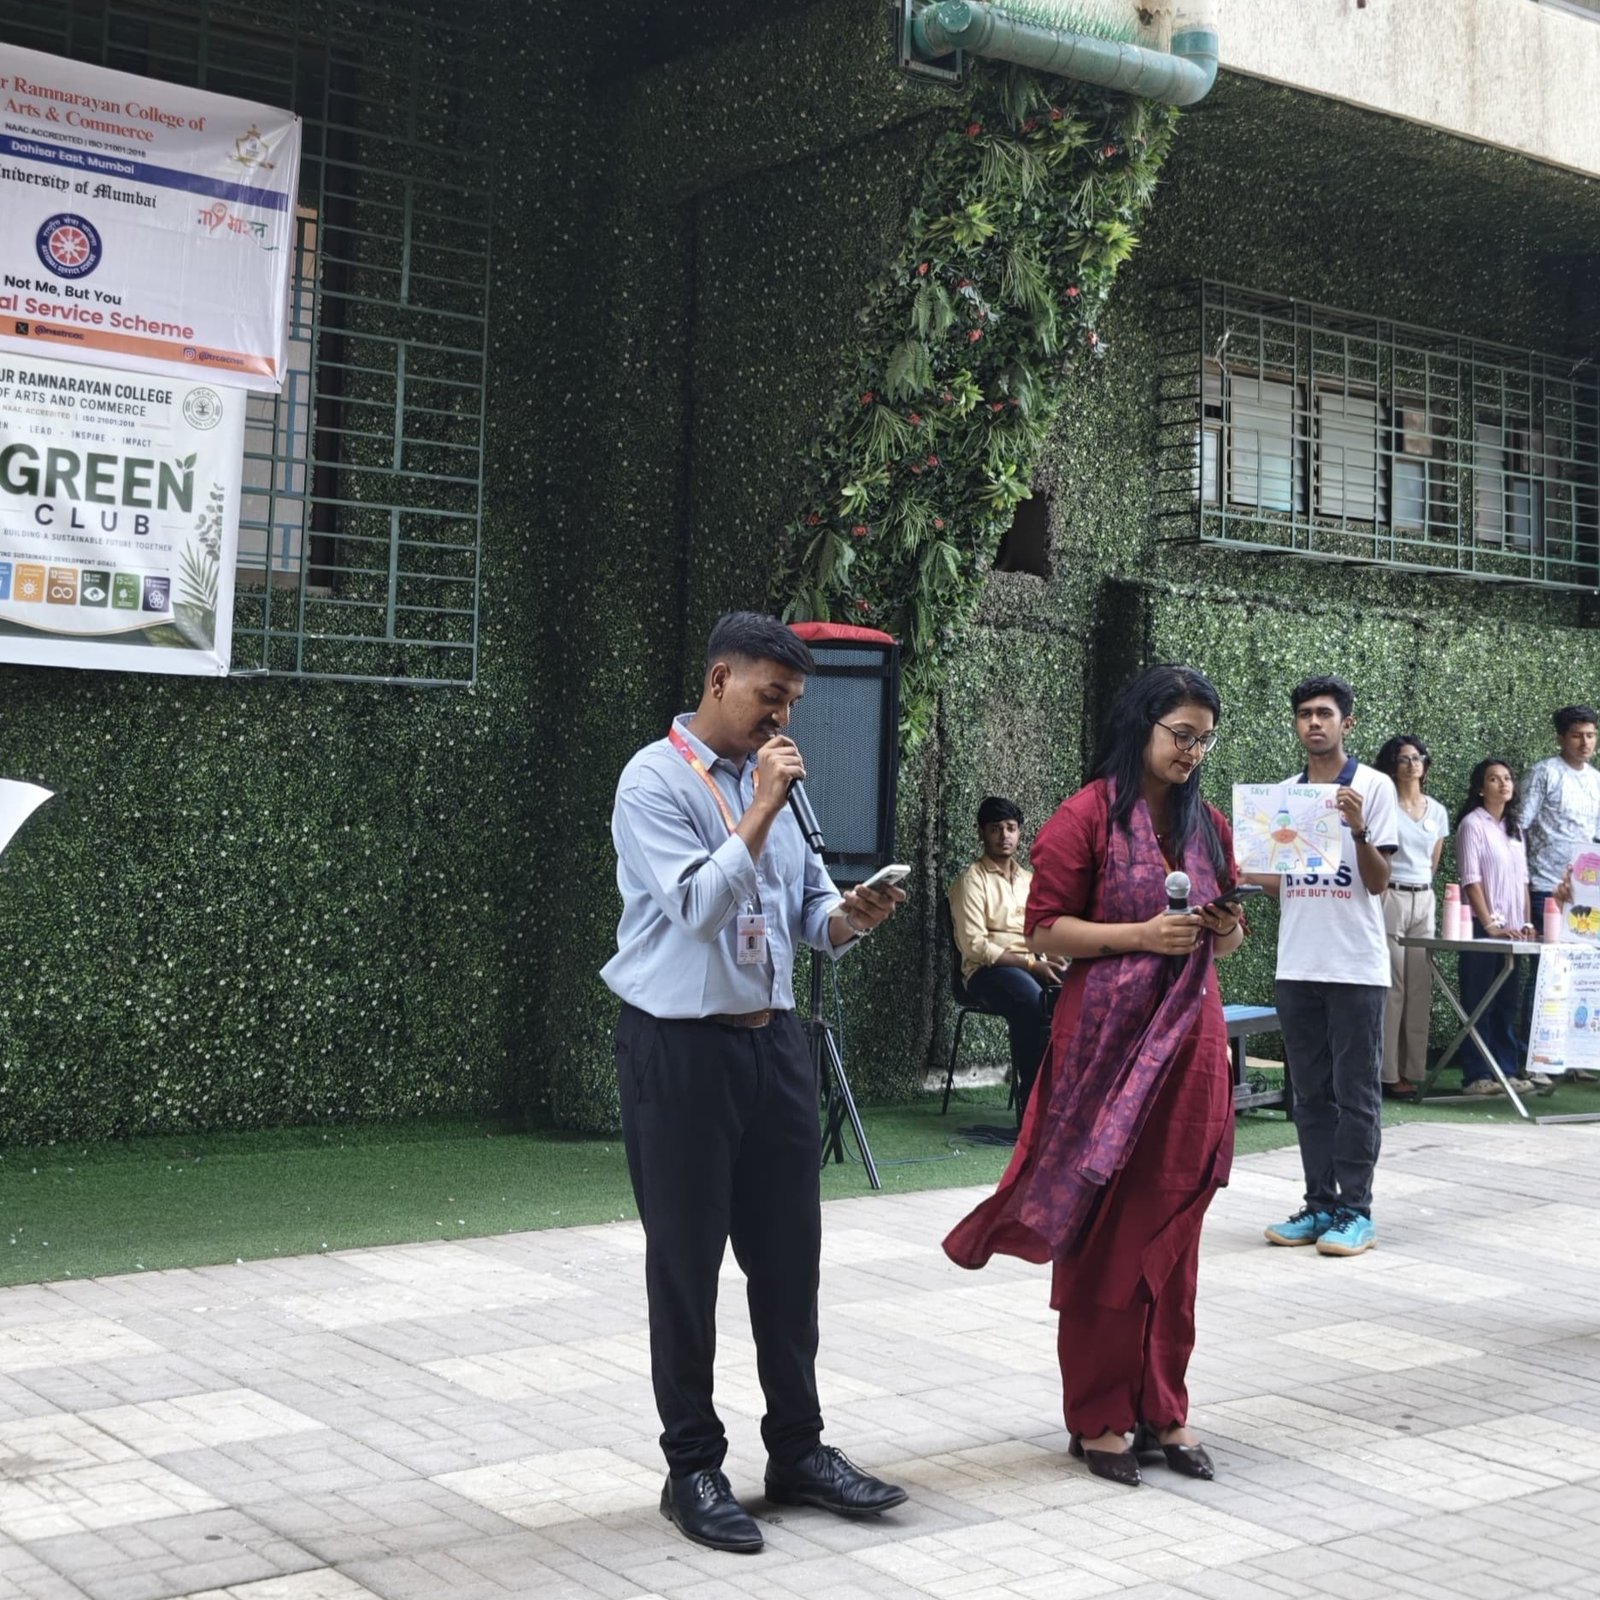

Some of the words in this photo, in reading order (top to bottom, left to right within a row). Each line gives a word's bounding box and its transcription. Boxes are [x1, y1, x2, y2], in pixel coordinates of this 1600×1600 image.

[4, 98, 41, 118] Arts
[45, 106, 60, 122] &
[65, 111, 154, 142] Commerce
[14, 76, 121, 114] Ramnarayan
[125, 102, 185, 128] College
[189, 116, 206, 132] of
[5, 122, 29, 134] NAAC
[31, 127, 84, 145] ACCREDITED
[88, 140, 103, 149] ISO
[11, 141, 57, 159] Dahisar
[59, 151, 86, 165] East,
[87, 157, 135, 174] Mumbai
[0, 165, 70, 193] niversity
[74, 180, 89, 195] of
[92, 183, 158, 208] Mumbai
[4, 274, 31, 291] Not
[35, 279, 61, 298] Me,
[65, 285, 90, 300] But
[94, 290, 122, 306] You
[25, 297, 104, 325] Service
[110, 312, 195, 340] Scheme
[14, 389, 45, 404] ARTS
[50, 392, 76, 407] AND
[80, 396, 147, 417] COMMERCE
[19, 370, 112, 397] RAMNARAYAN
[114, 385, 173, 405] COLLEGE
[2, 404, 22, 413] NAAC
[26, 407, 71, 420] ACCREDITED
[83, 415, 95, 423] ISO
[30, 424, 52, 436] LEAD
[72, 430, 105, 443] INSPIRE
[122, 436, 152, 448] IMPACT
[0, 443, 197, 513] GREEN
[34, 503, 151, 536] CLUB
[4, 528, 40, 538] BUILDING
[43, 532, 49, 540] A
[52, 533, 103, 545] SUSTAINABLE
[135, 541, 173, 552] TOGETHER
[1308, 888, 1327, 898] BUT
[1331, 889, 1352, 899] YOU
